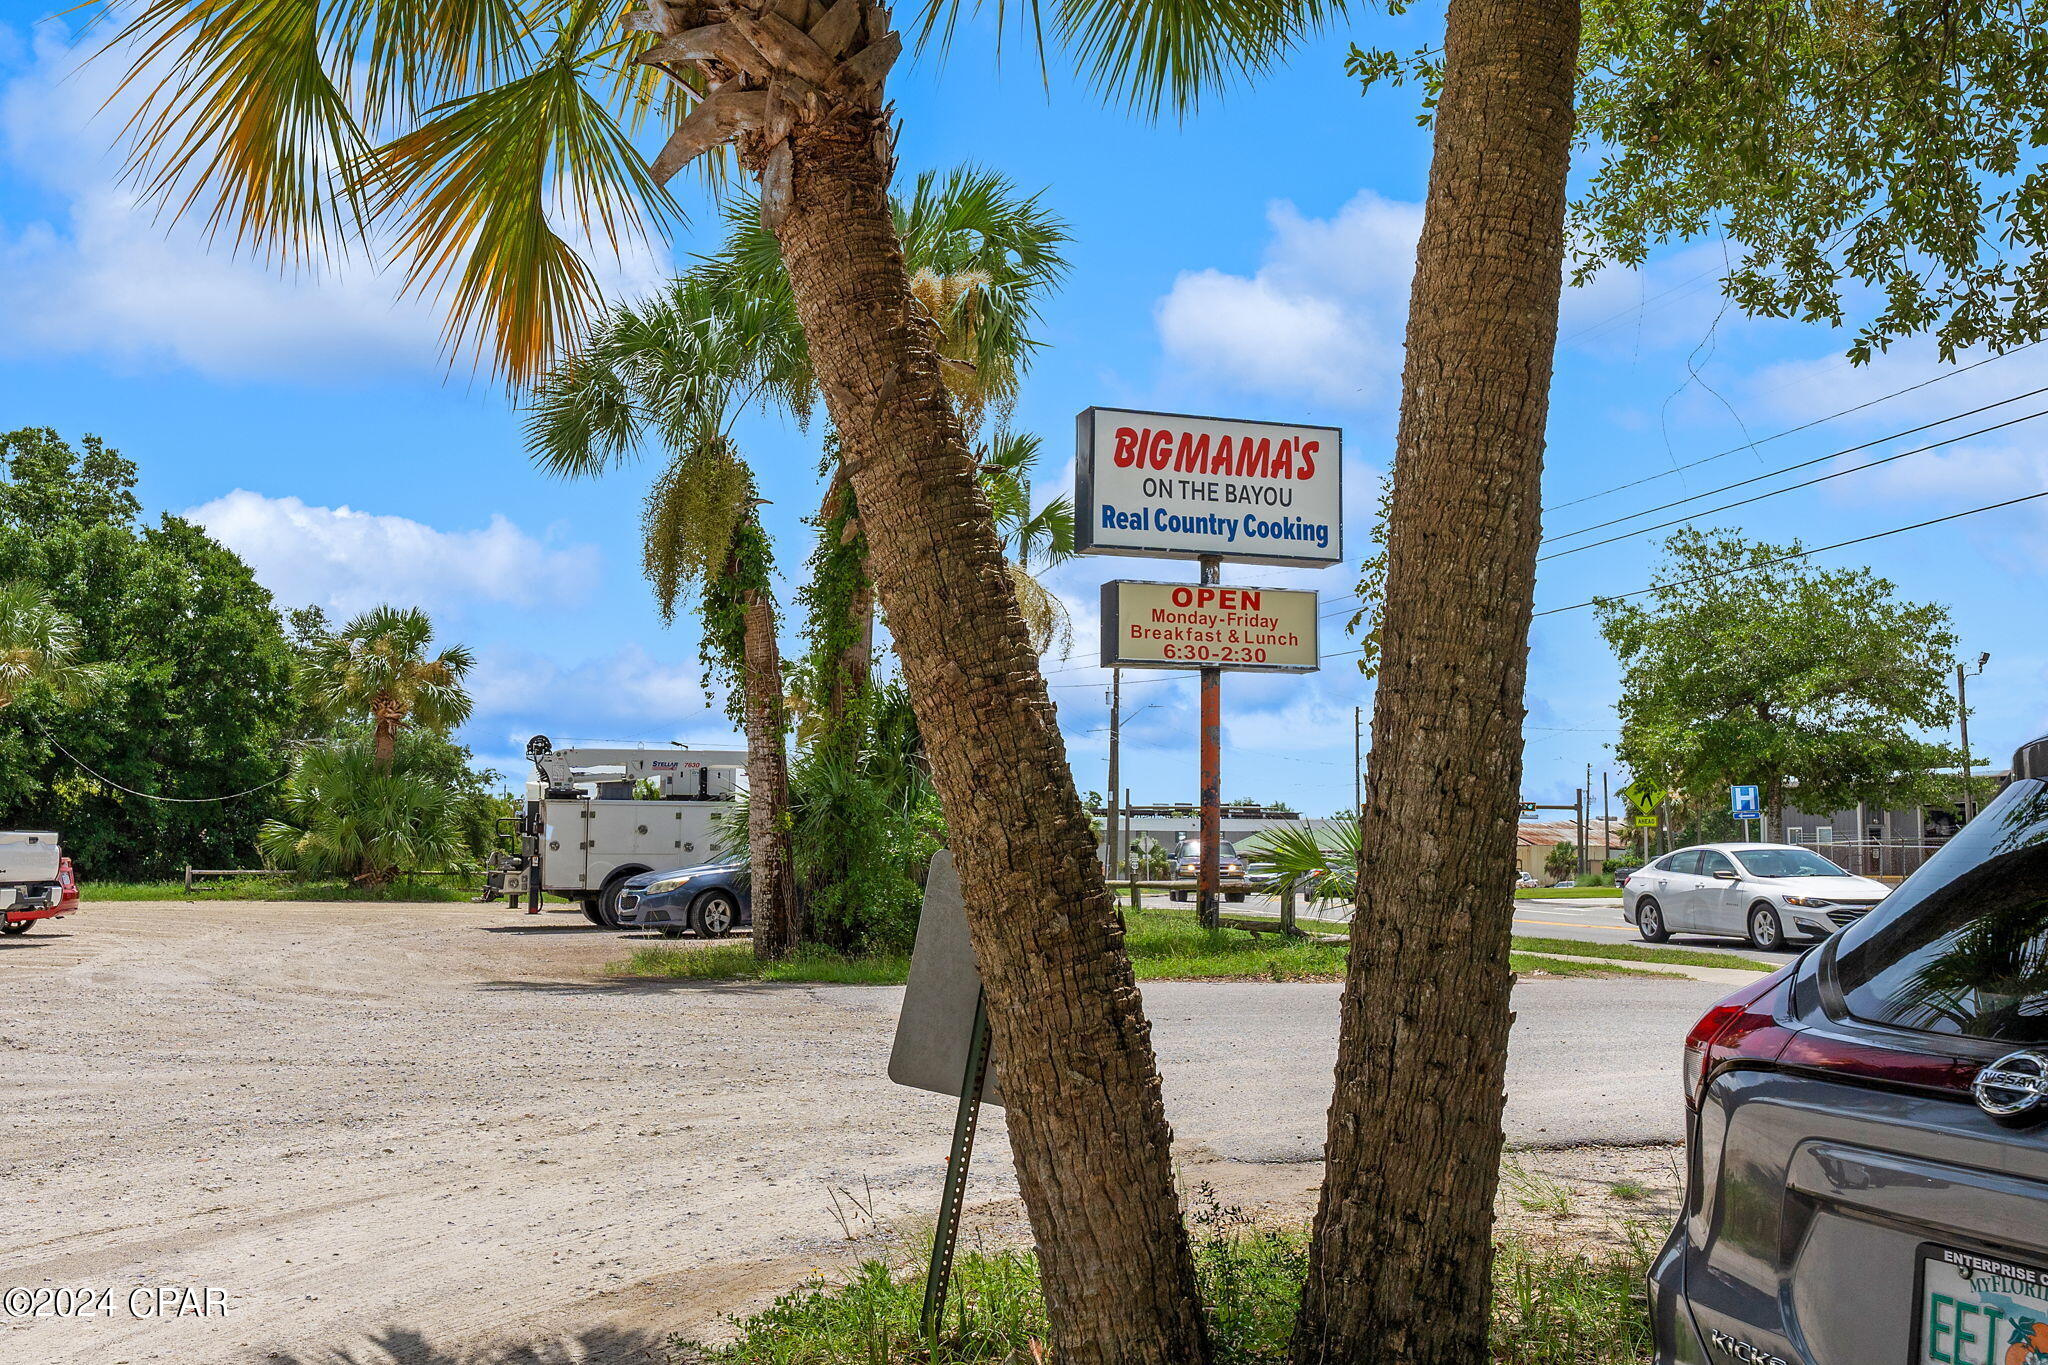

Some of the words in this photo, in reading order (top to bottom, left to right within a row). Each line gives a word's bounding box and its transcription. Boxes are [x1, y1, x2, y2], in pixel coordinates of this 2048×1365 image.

[1143, 477, 1173, 499] ON
[1178, 480, 1219, 502] THE
[1225, 483, 1293, 508] BAYOU
[1102, 504, 1149, 531] Real
[1154, 508, 1238, 542] Country
[1243, 513, 1328, 548] Cooking
[1171, 587, 1261, 612] OPEN
[1152, 608, 1279, 632] Monday-Friday
[1131, 624, 1222, 643] Breakfast
[1228, 630, 1240, 643] &
[1244, 630, 1299, 647] Lunch
[1163, 643, 1267, 663] 6:30-2:30
[1736, 787, 1756, 810] H
[1981, 1072, 2042, 1089] NISSAN
[1944, 1250, 2036, 1283] ENTERPRISE
[1970, 1275, 2048, 1302] MYFLORI
